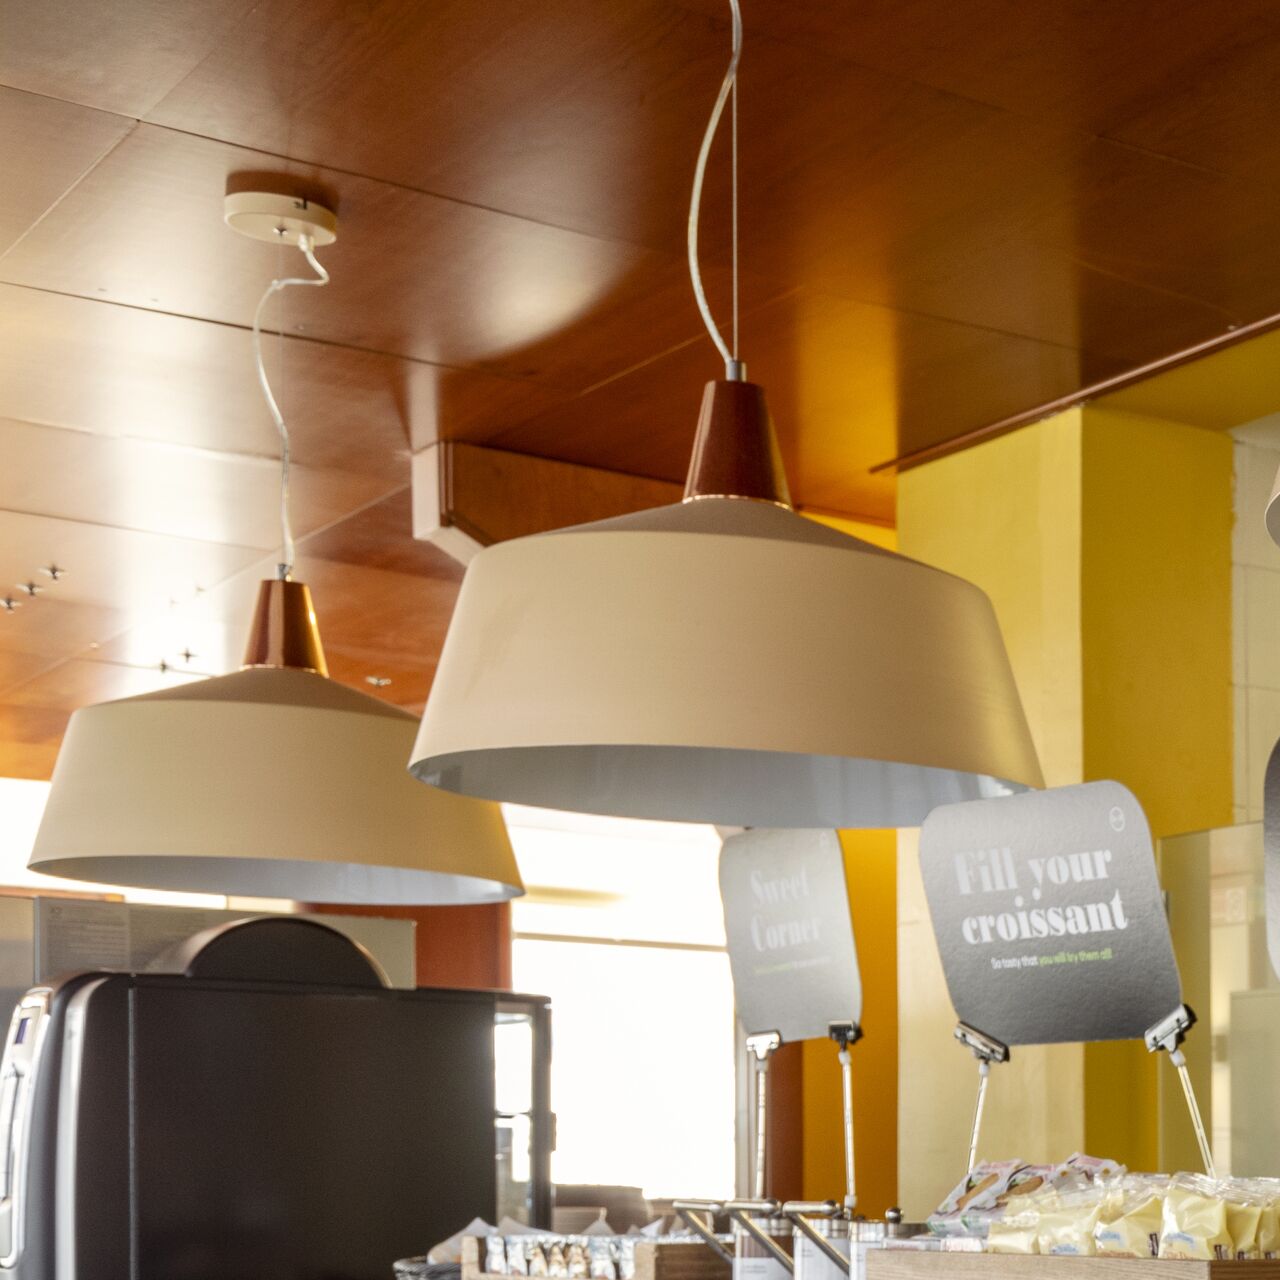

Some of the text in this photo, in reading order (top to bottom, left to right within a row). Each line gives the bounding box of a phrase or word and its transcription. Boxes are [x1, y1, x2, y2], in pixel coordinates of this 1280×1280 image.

[954, 847, 1112, 900] Fill your
[751, 912, 822, 953] Corner
[962, 888, 1129, 945] croissant
